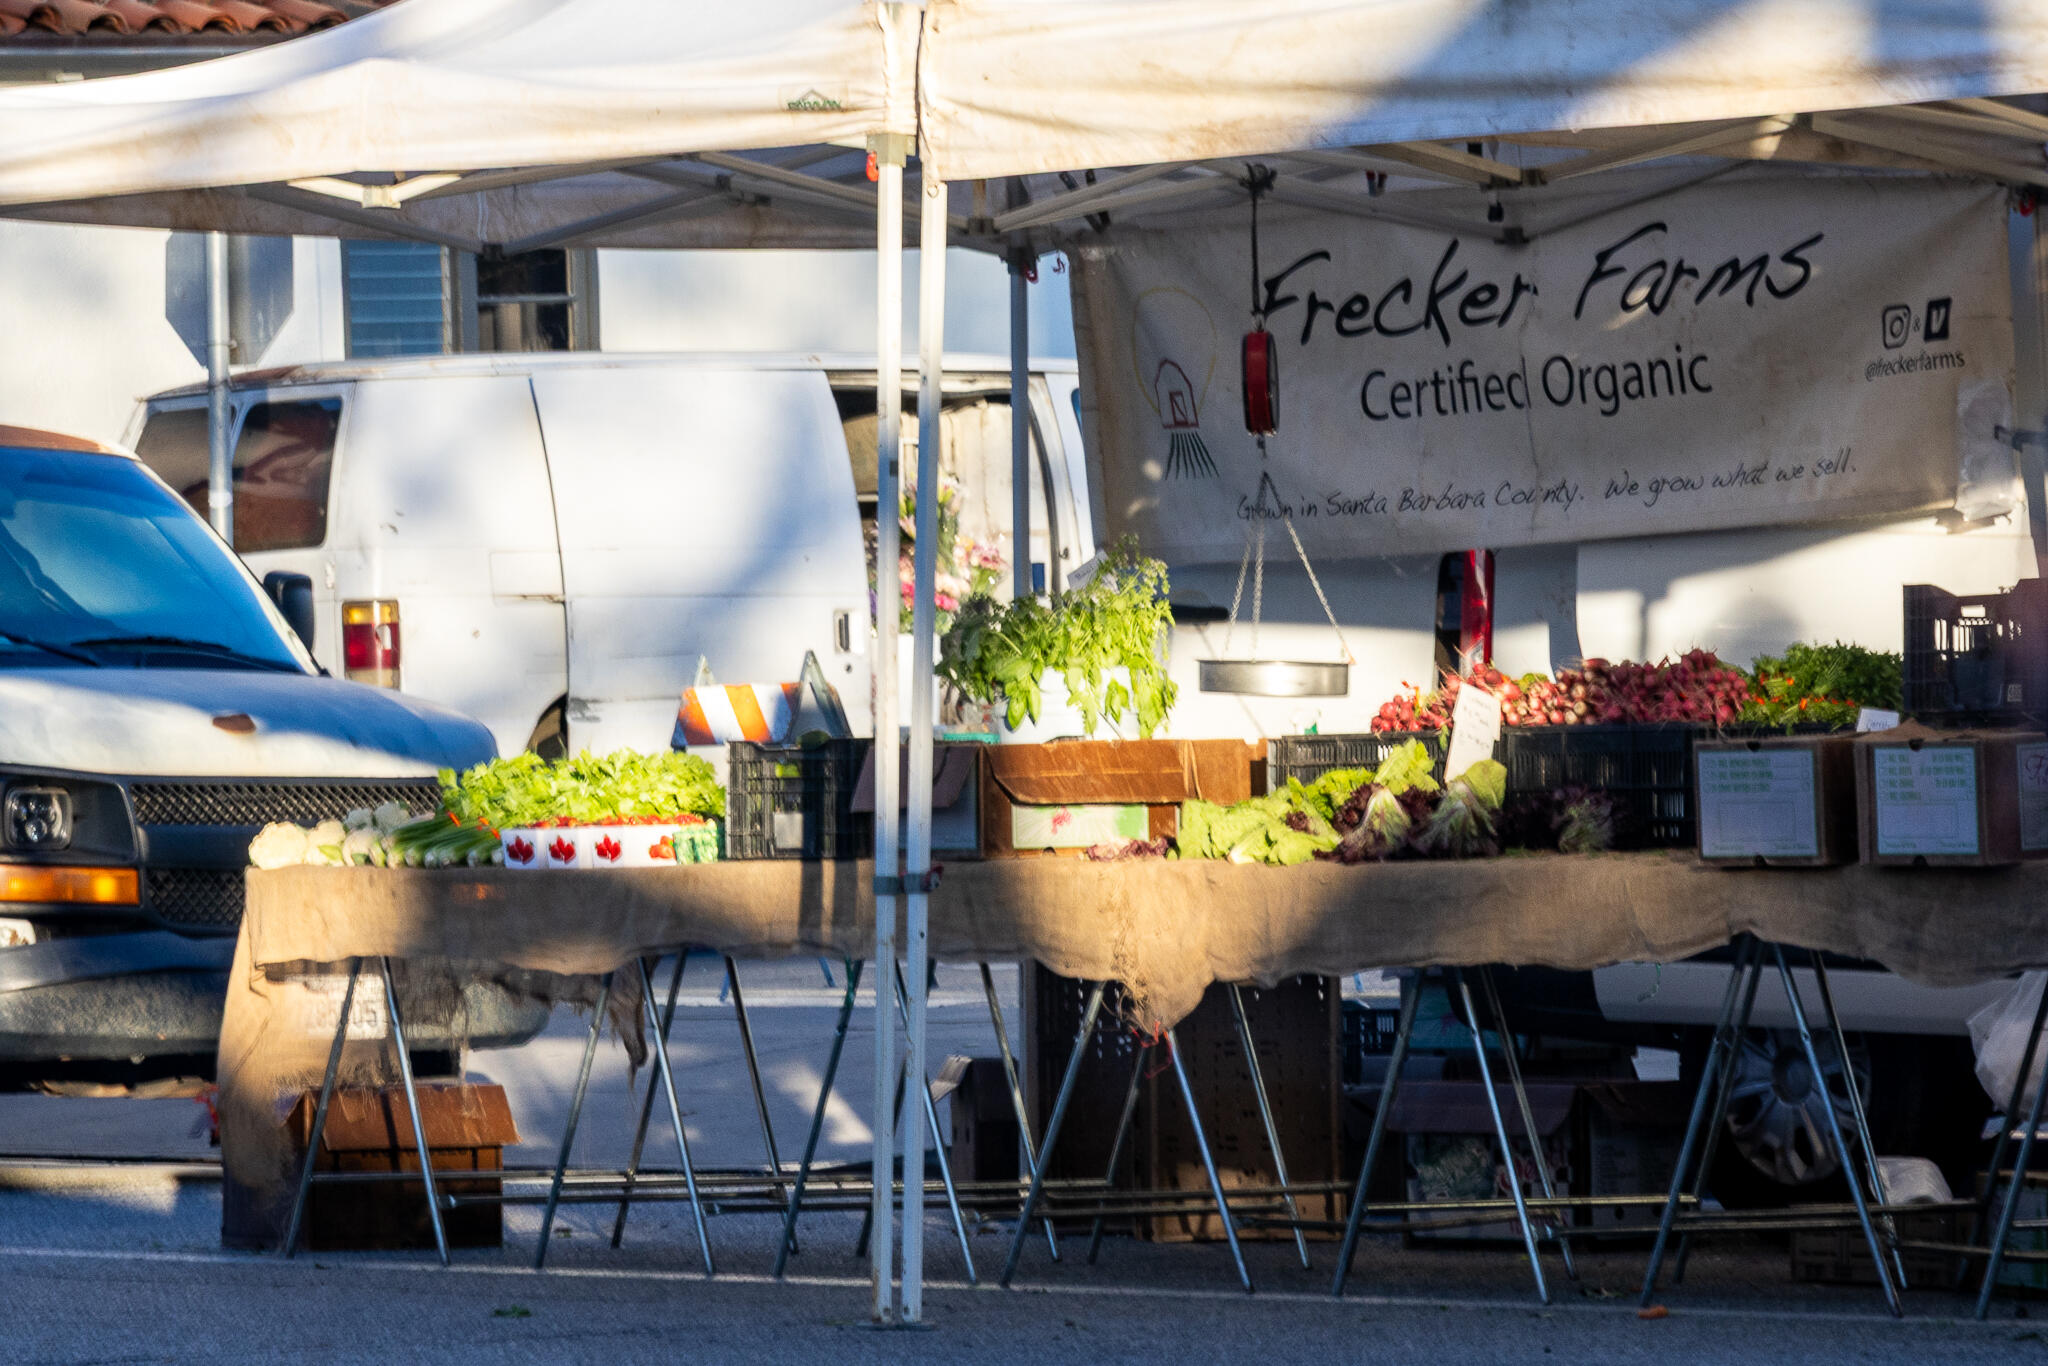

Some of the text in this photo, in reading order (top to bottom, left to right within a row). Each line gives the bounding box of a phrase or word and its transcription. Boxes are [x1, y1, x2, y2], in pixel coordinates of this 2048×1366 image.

[1263, 222, 1824, 347] Frecker Farms
[1361, 344, 1713, 421] Certified Organic
[1865, 349, 1966, 382] @freckerfarms
[1236, 493, 1293, 521] Grown
[1300, 495, 1318, 517] in
[1326, 489, 1388, 517] Santa
[1399, 482, 1486, 512] Barbara
[1604, 467, 1639, 499] We
[1643, 474, 1704, 507] grow
[1711, 461, 1769, 488] what
[1775, 464, 1804, 483] we
[1813, 446, 1857, 478] sell.
